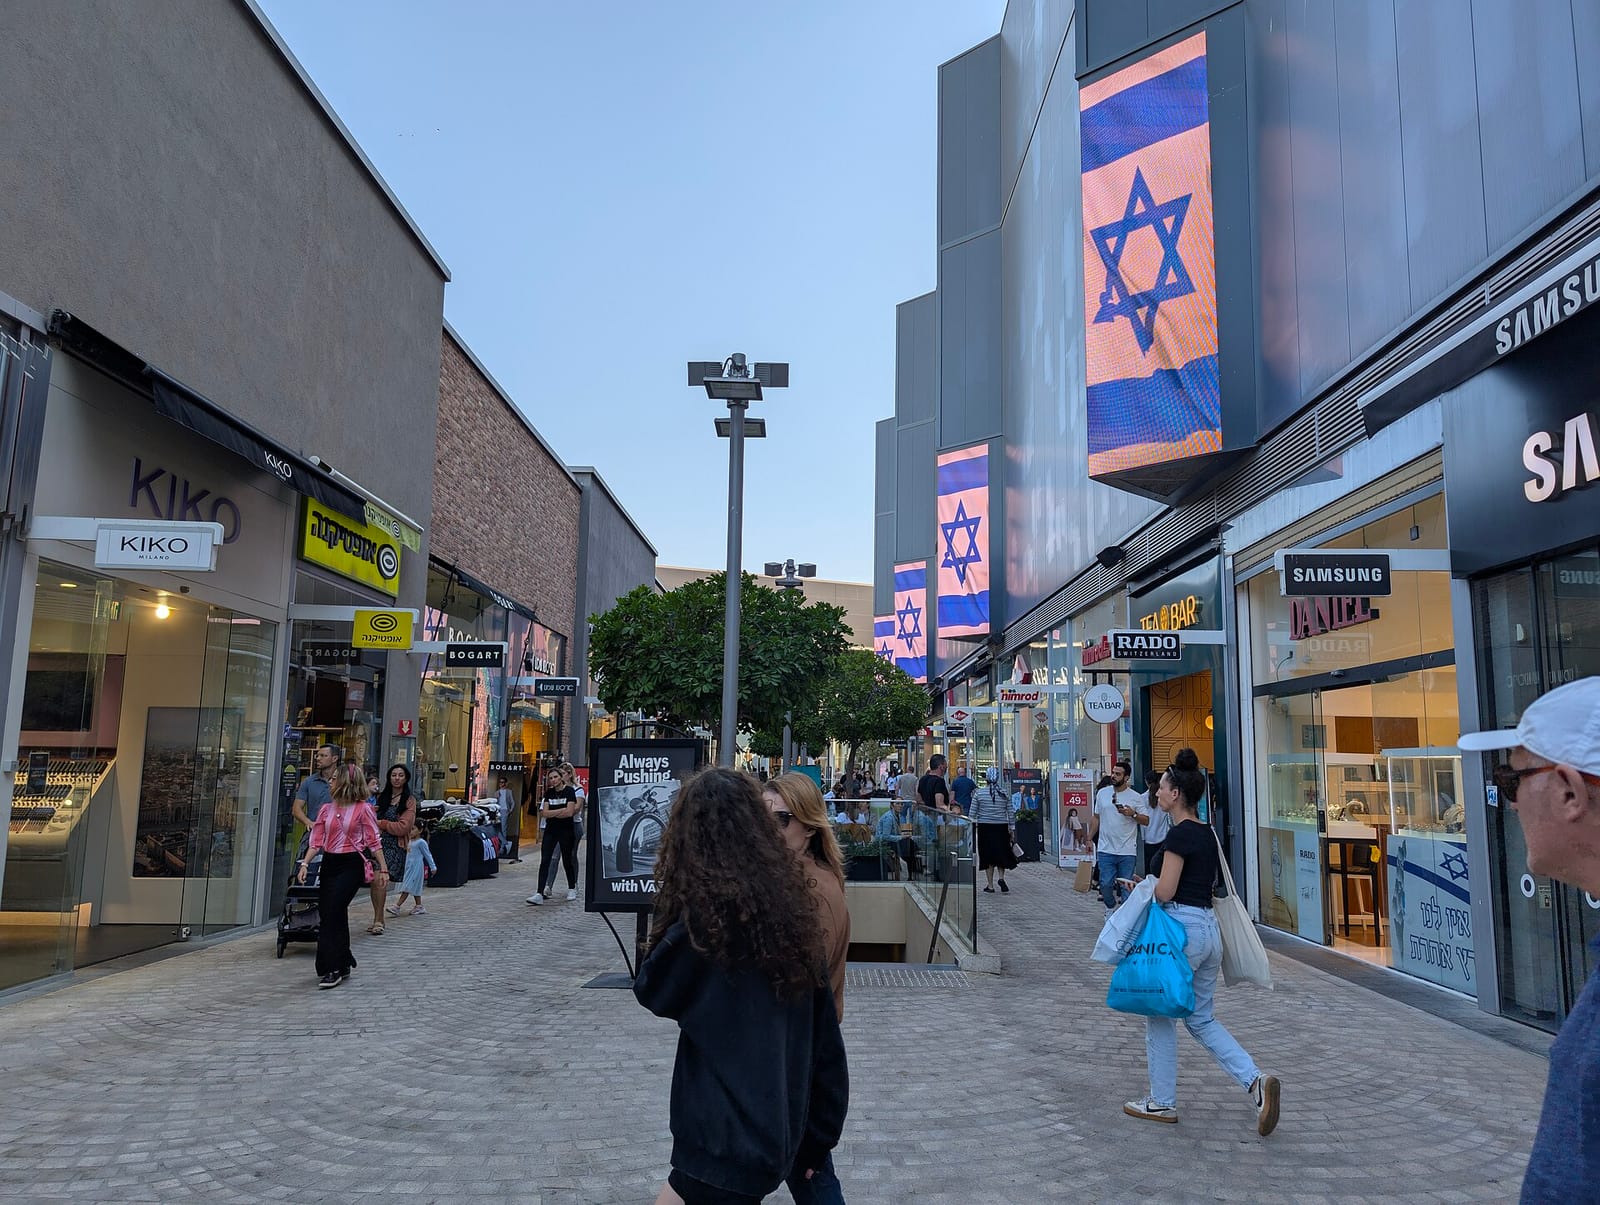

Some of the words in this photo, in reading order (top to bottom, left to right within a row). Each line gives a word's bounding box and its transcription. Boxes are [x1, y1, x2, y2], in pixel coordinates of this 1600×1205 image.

[263, 450, 292, 478] KIKO
[121, 536, 188, 553] KIKO
[311, 510, 377, 564] אופטיקנה
[1293, 567, 1382, 583] SAMSUNG
[1139, 612, 1160, 631] TEA
[1170, 595, 1197, 631] BAR
[361, 634, 402, 643] אופטיקנה
[1117, 636, 1177, 649] RADO
[449, 651, 500, 660] BOGART
[1000, 691, 1039, 701] nimrod
[1088, 701, 1105, 710] TEA
[1104, 701, 1122, 710] BAR
[618, 754, 669, 771] Always
[1069, 796, 1081, 805] 49
[611, 879, 638, 893] with
[1420, 895, 1443, 931] לנו
[1445, 906, 1472, 940] אין
[1409, 933, 1455, 972] אחרת
